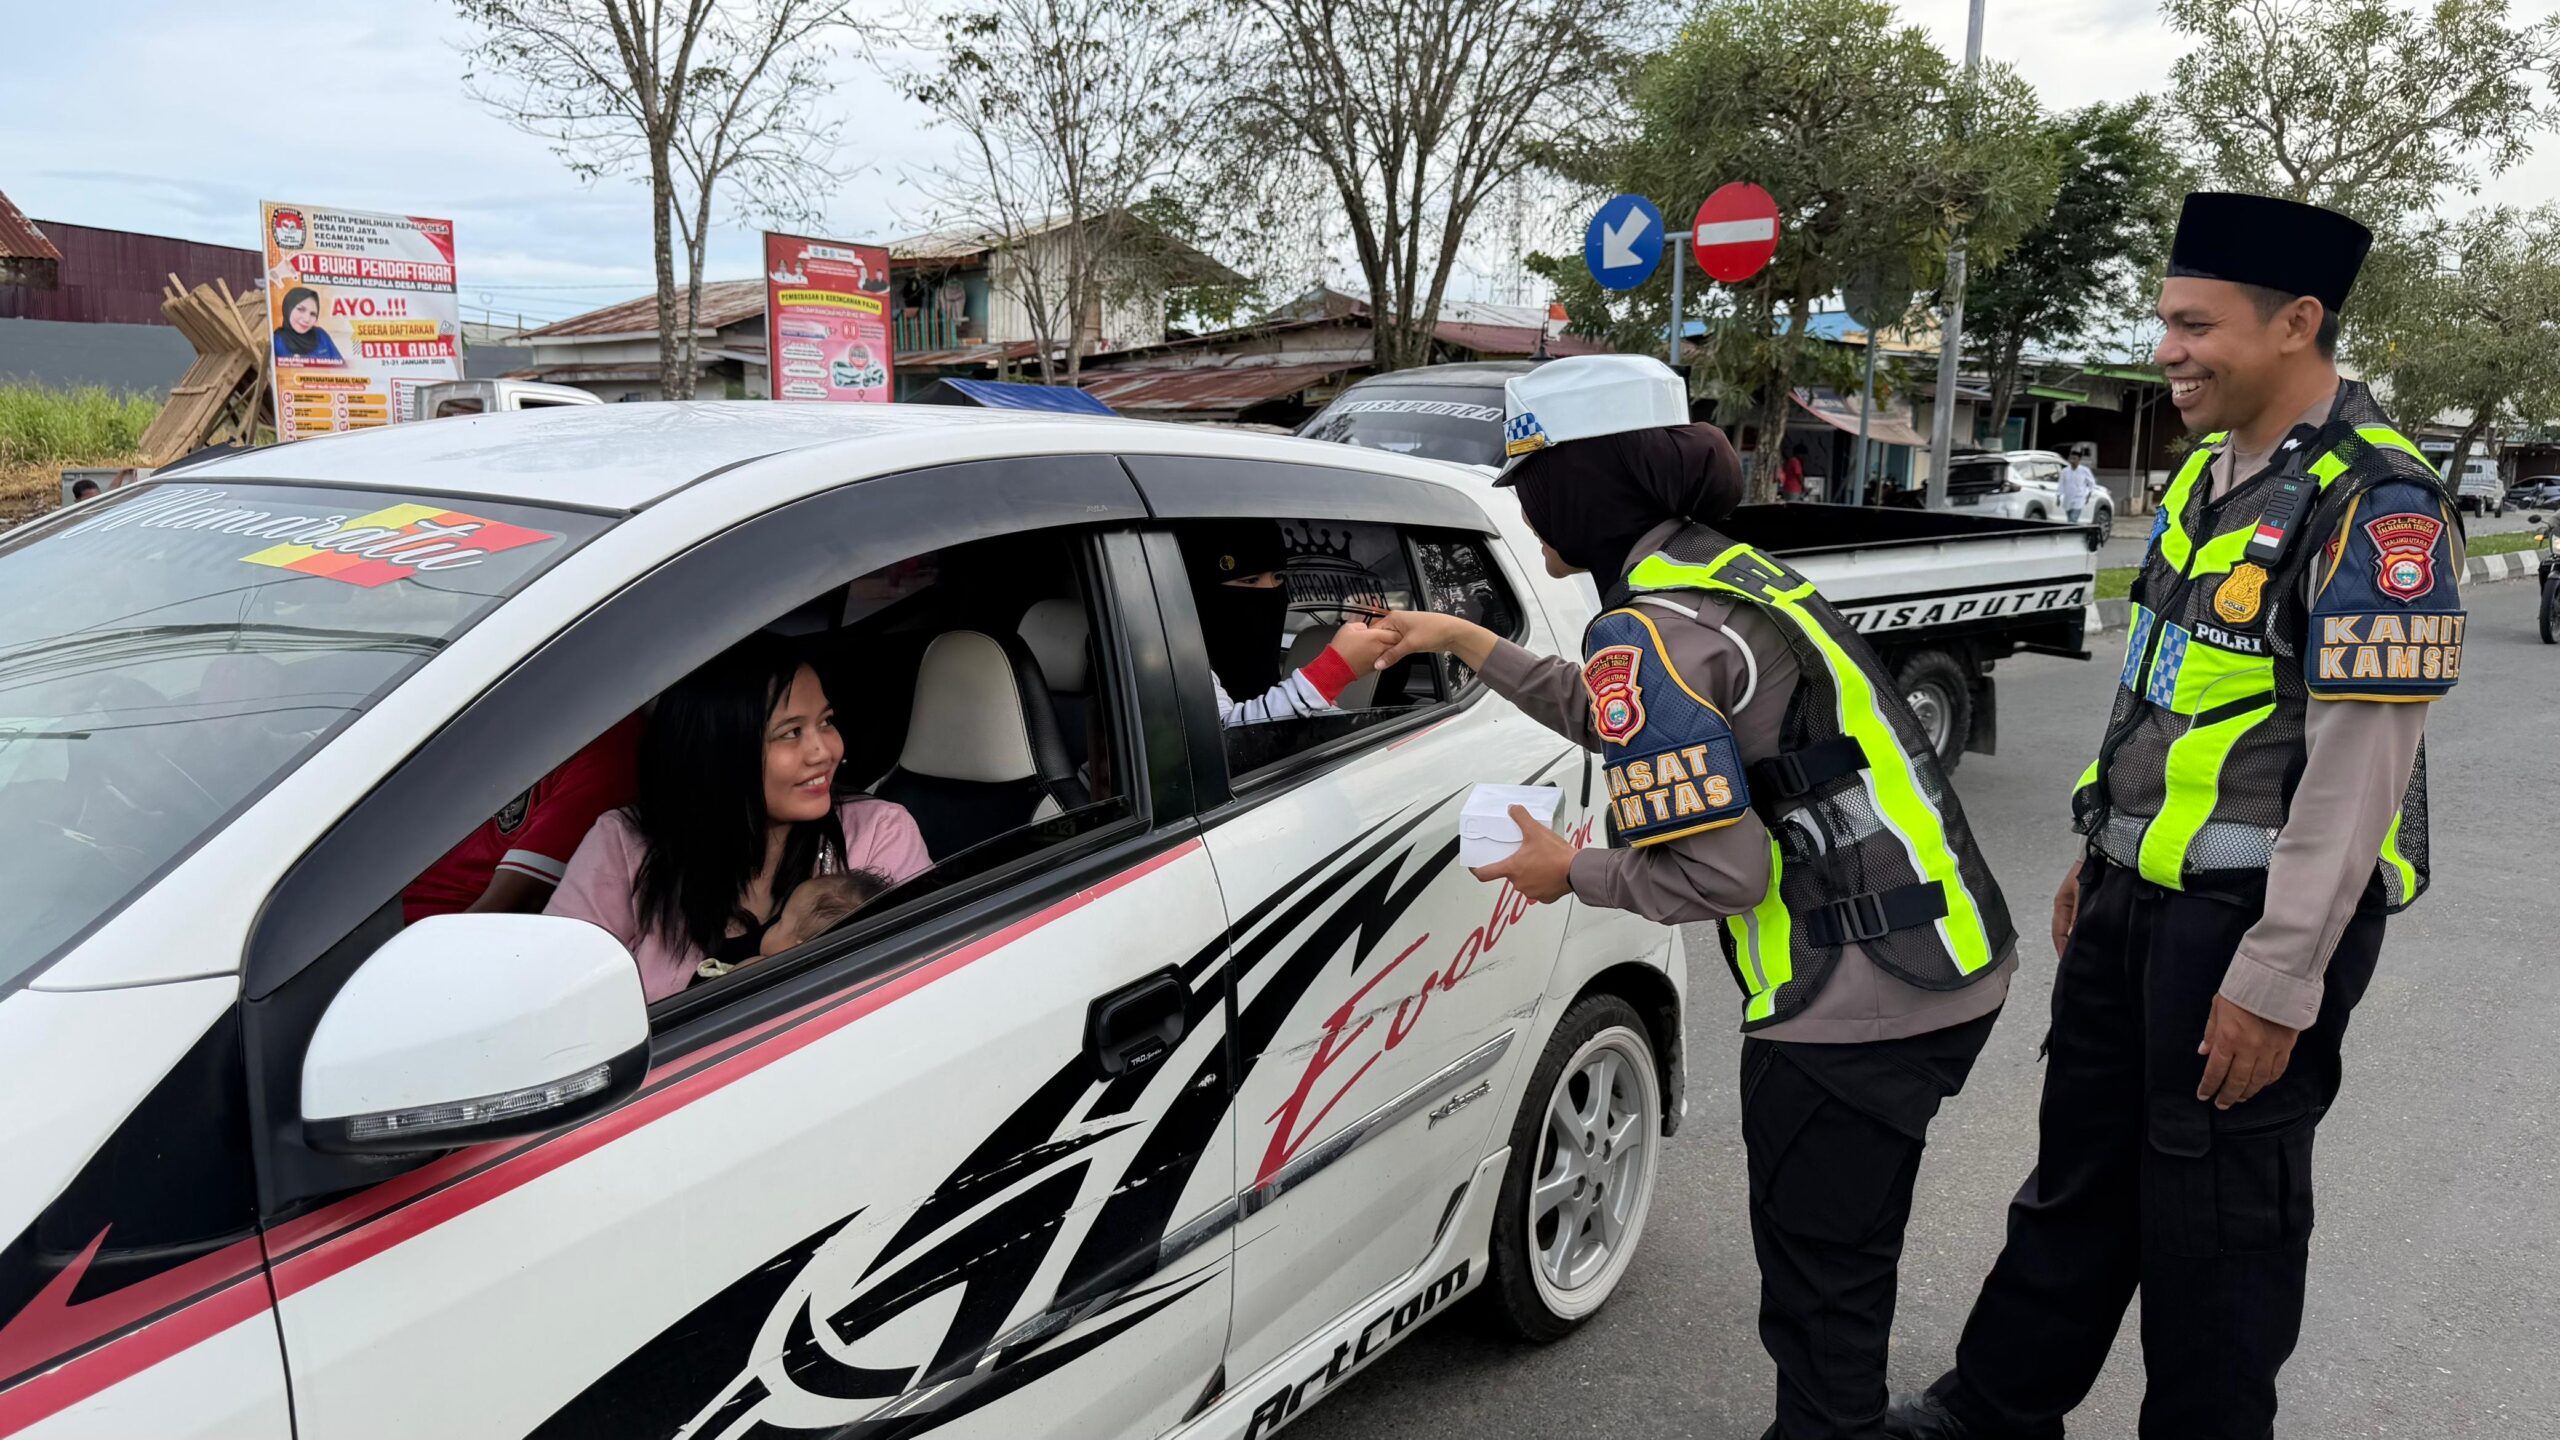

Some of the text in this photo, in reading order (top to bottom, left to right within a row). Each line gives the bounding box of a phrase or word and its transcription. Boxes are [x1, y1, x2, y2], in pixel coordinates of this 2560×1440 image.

[313, 214, 449, 233] PANITIA PEMILIHAN KEPALA DESA
[314, 223, 377, 235] DESA FIDI JAYA
[314, 233, 390, 246] KECAMATAN WEDA
[315, 241, 365, 251] TAHUN 2026
[298, 255, 452, 282] DI BUKA PENDAFTARAN
[303, 274, 452, 292] BAKAL CALON KEPALA DESA FIDI JAYA
[357, 324, 435, 336] SEGERA DAFTARKAN
[364, 342, 401, 357] DIRI
[2195, 622, 2262, 653] POLRI
